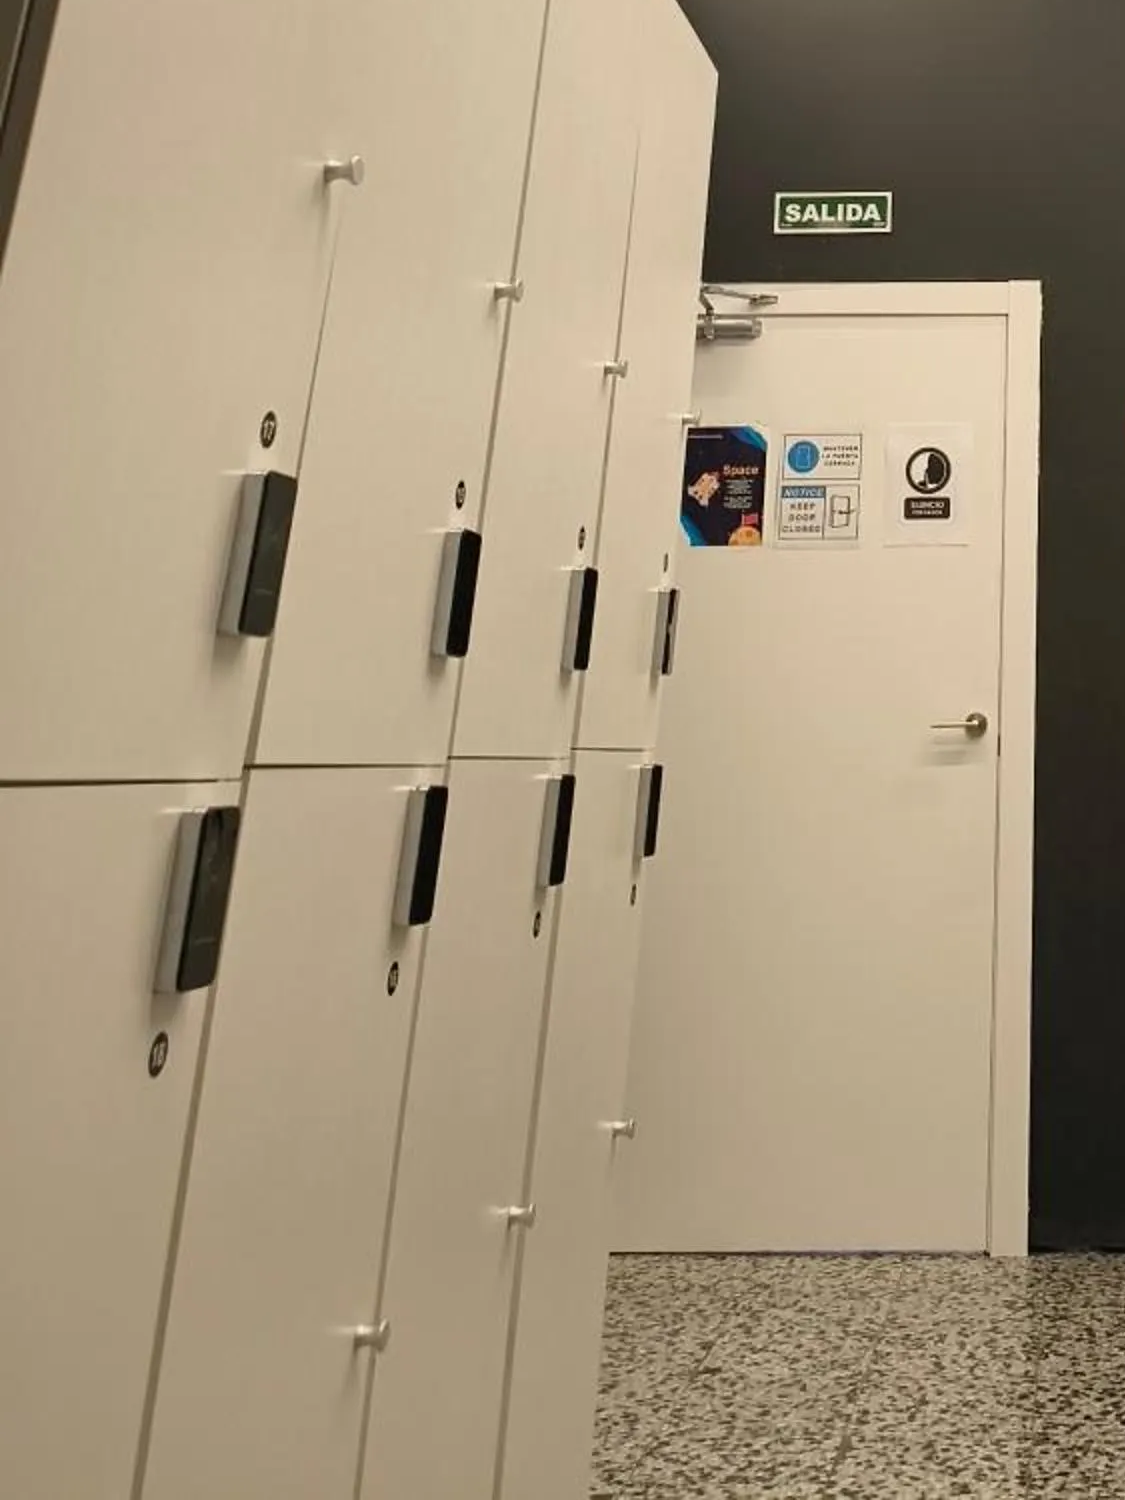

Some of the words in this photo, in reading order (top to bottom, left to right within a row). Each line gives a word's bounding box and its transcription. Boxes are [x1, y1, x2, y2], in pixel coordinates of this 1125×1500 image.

[785, 203, 881, 223] SALIDA
[722, 464, 759, 476] Space
[783, 487, 823, 497] NOTICE
[790, 502, 816, 510] KEEP
[788, 513, 816, 522] DOOR
[782, 525, 821, 533] CLOSED
